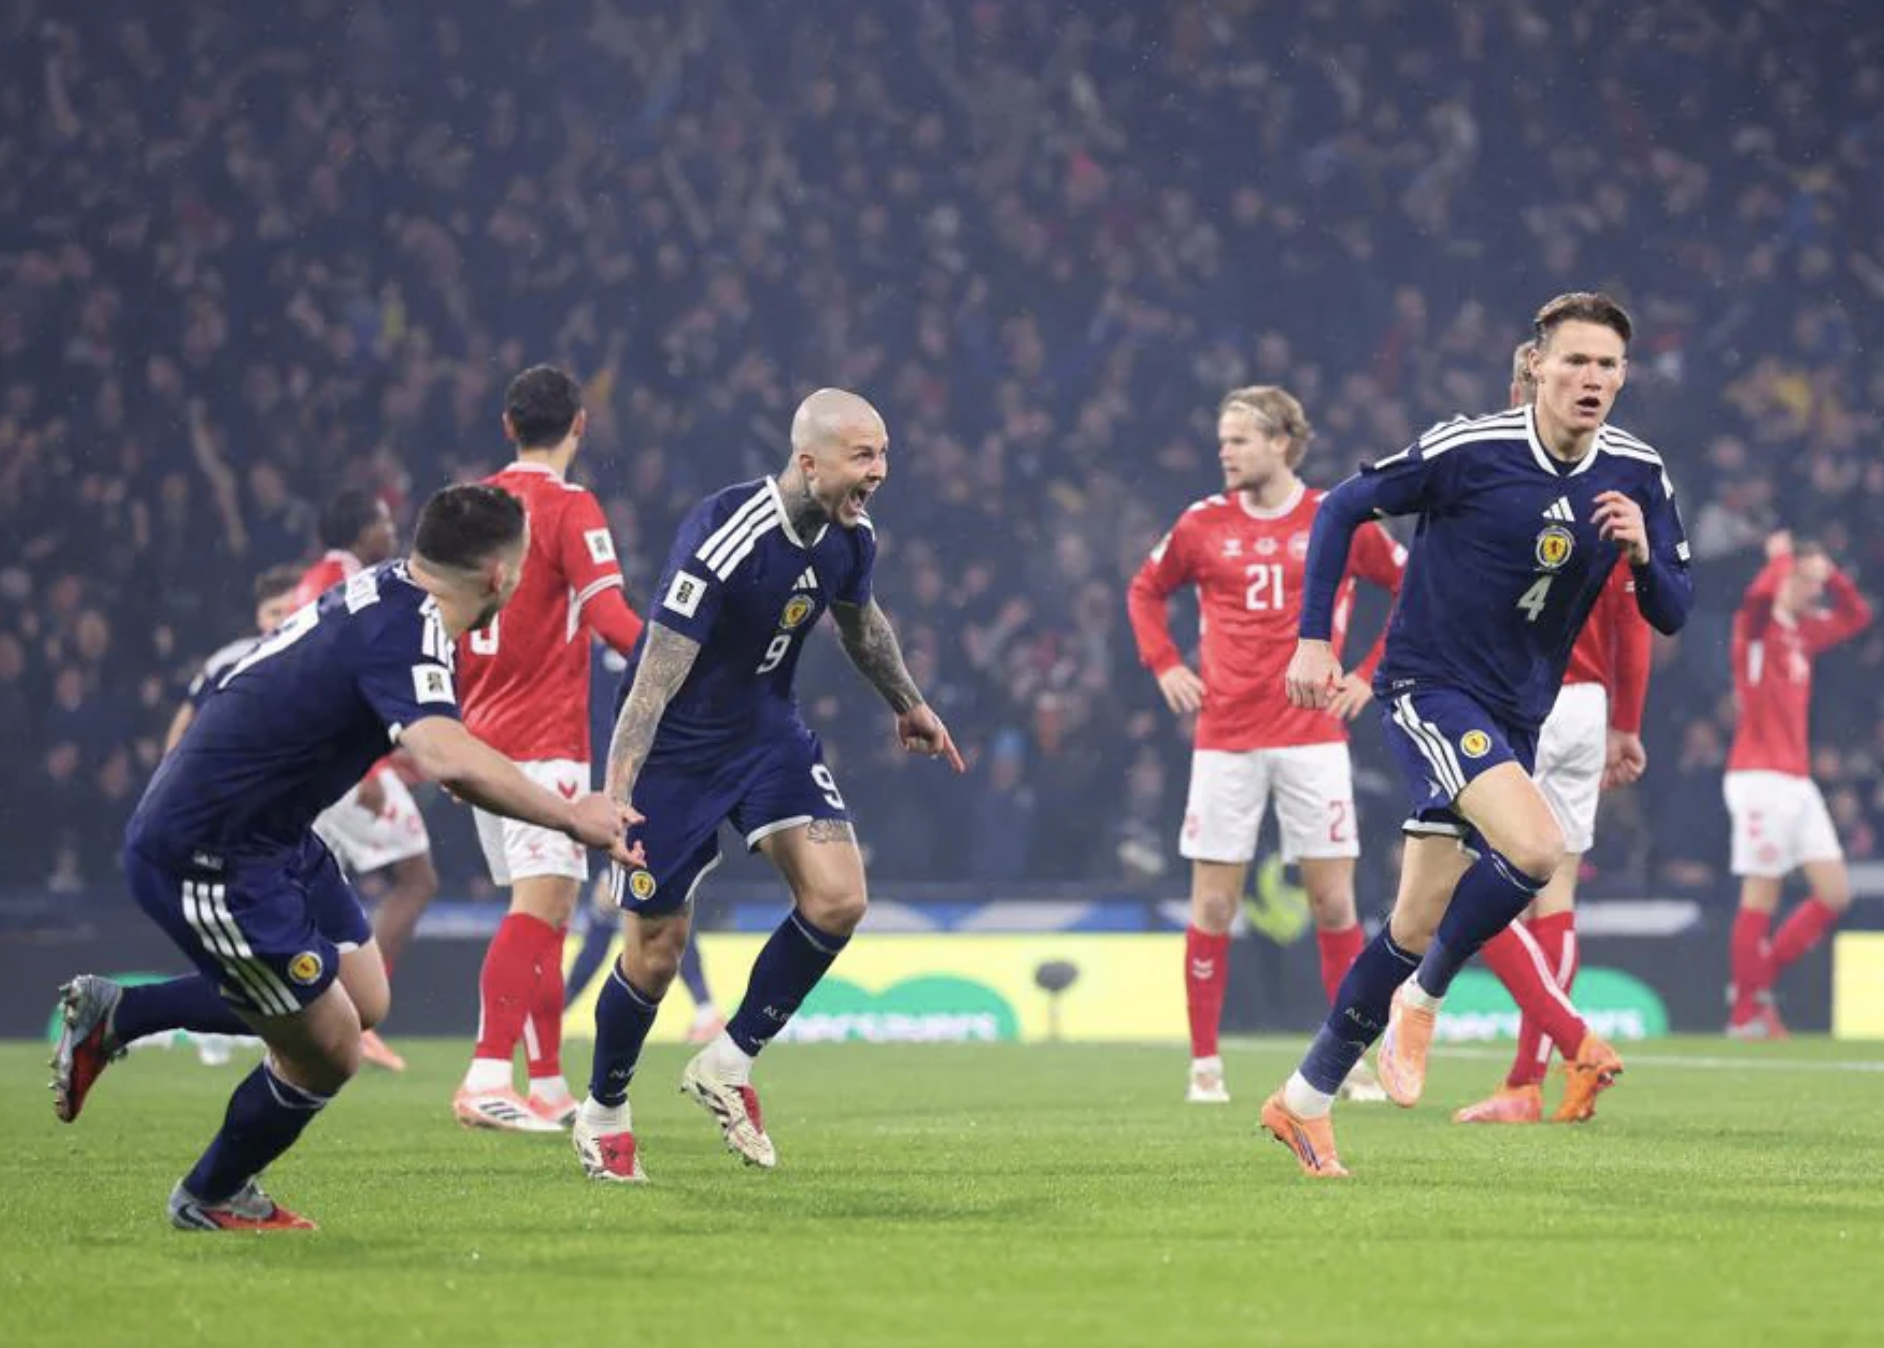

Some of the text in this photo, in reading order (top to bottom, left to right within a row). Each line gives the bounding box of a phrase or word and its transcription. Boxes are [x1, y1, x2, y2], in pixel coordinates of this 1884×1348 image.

[1245, 563, 1284, 610] 21
[1516, 574, 1554, 622] 4
[755, 634, 792, 674] 9
[810, 763, 845, 810] 9
